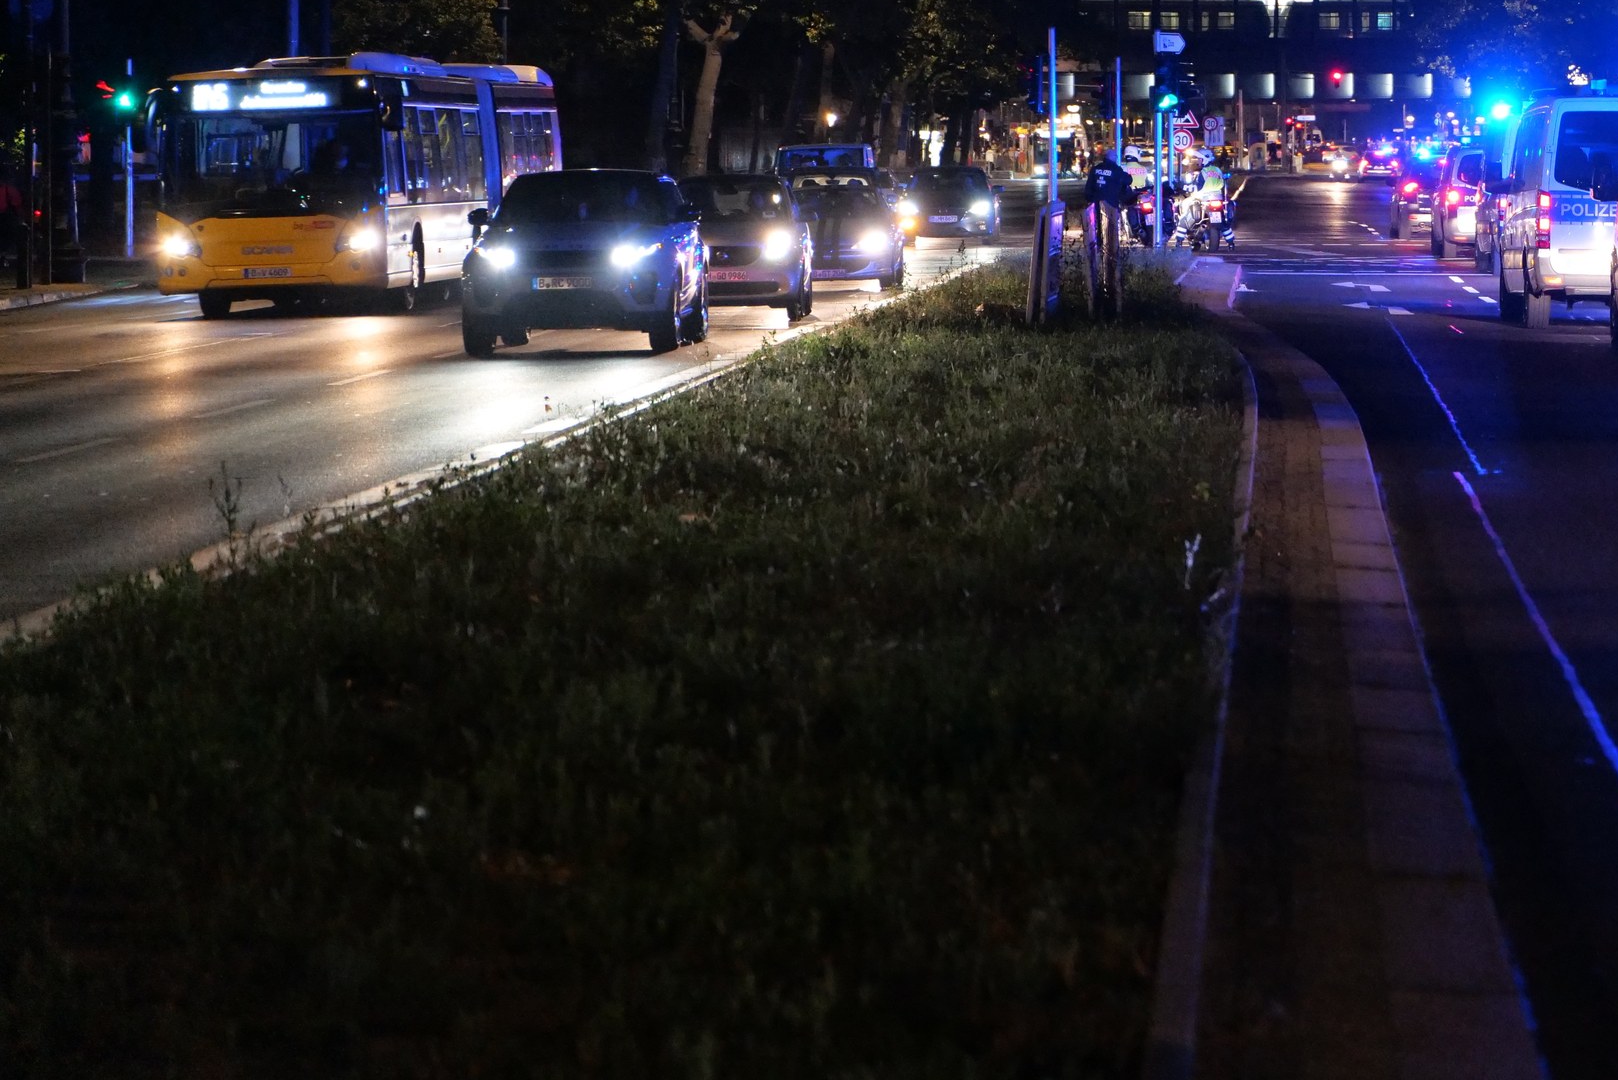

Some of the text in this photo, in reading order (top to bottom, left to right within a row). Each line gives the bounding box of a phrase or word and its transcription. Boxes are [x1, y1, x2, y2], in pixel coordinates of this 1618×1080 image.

[1206, 119, 1216, 128] 30
[1174, 136, 1189, 146] 30
[1560, 203, 1618, 217] POLIZE
